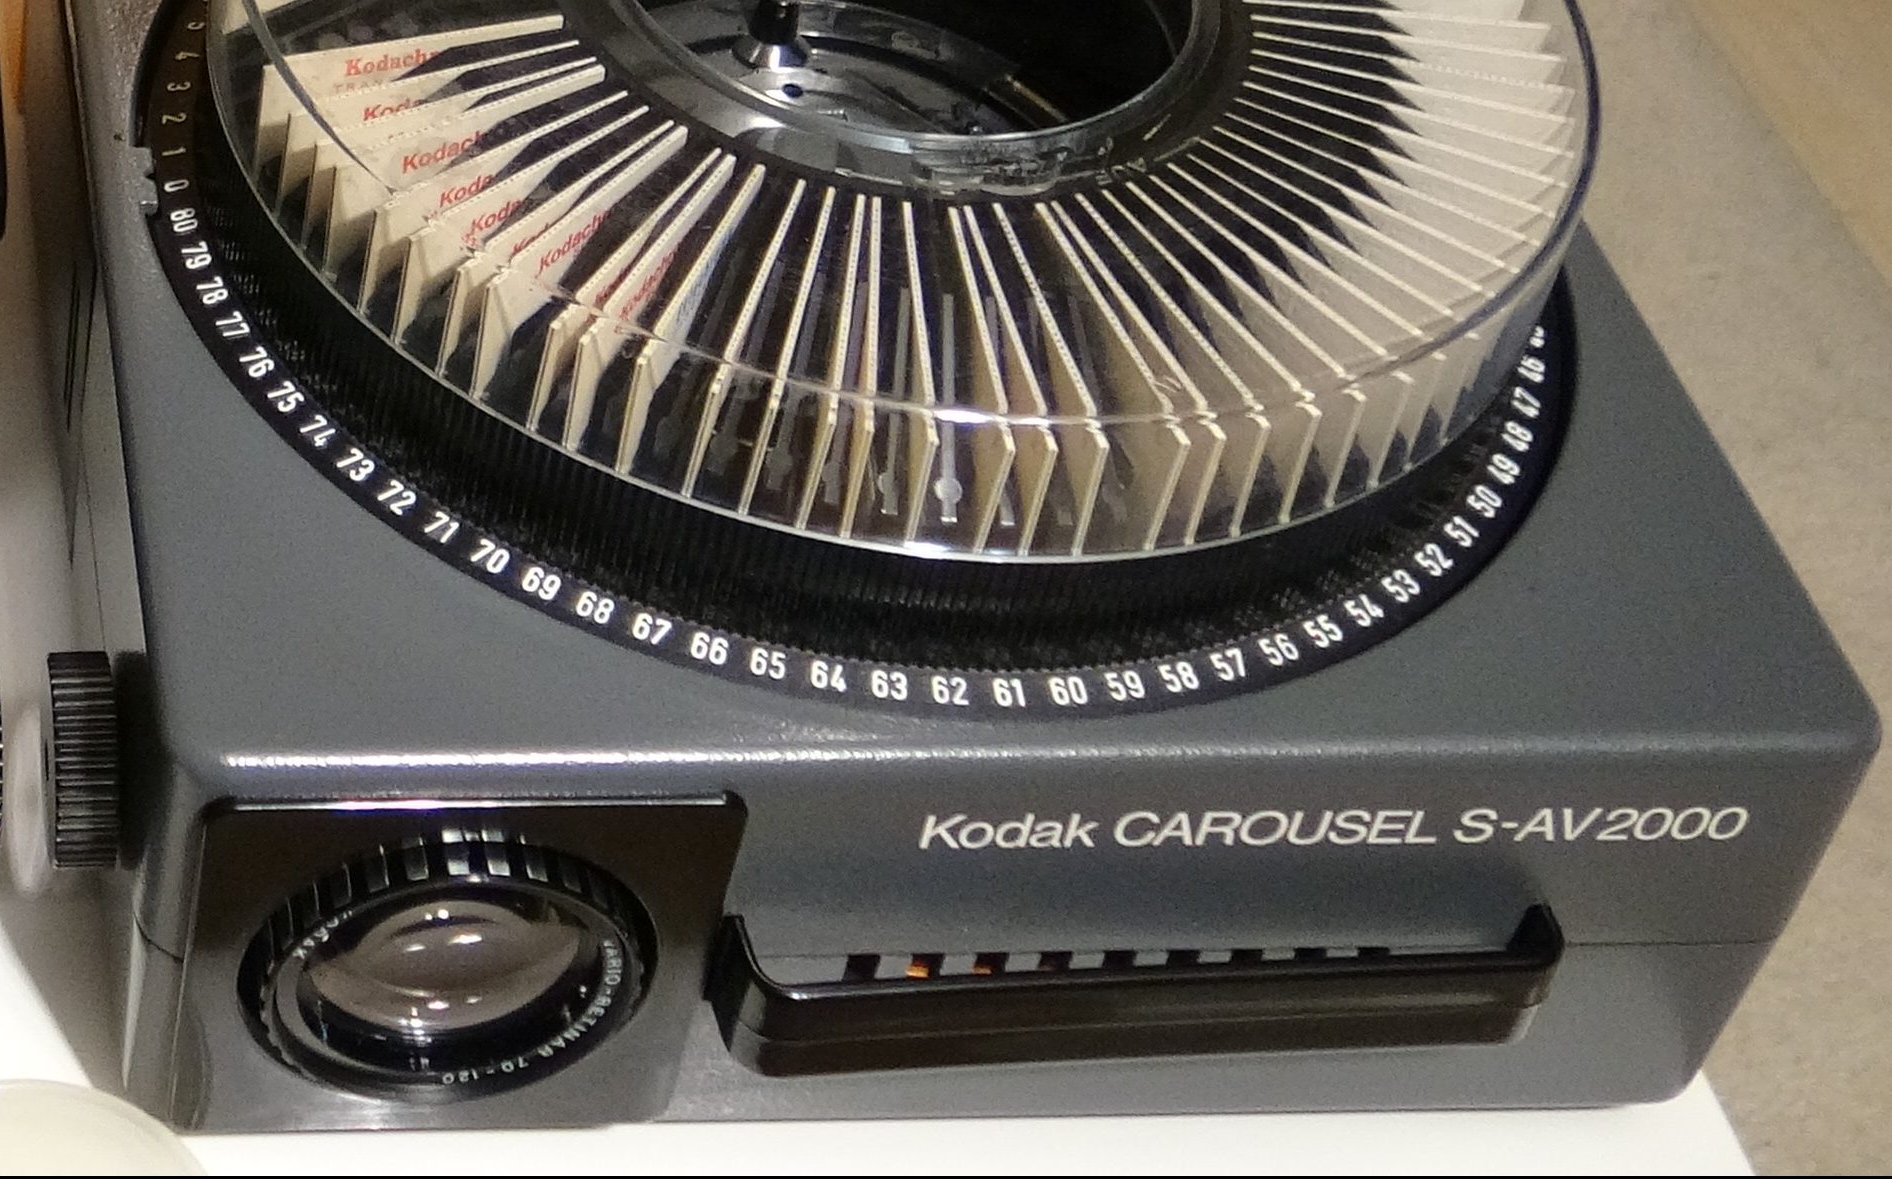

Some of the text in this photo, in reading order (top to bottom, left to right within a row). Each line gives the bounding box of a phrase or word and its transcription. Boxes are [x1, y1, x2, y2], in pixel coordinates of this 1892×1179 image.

[161, 112, 187, 125] 2
[170, 208, 198, 233] 80
[181, 241, 212, 270] 79
[196, 276, 229, 305] 78
[215, 310, 250, 337] 77
[239, 345, 275, 378] 76
[267, 380, 305, 413] 75
[1511, 386, 1541, 418] 47
[299, 414, 336, 447] 74
[1501, 421, 1533, 452] 48
[336, 447, 375, 482] 73
[1487, 453, 1520, 485] 49
[377, 479, 417, 516] 72
[1466, 484, 1502, 518] 50
[424, 510, 460, 544] 71
[1443, 516, 1479, 547] 51
[470, 538, 510, 574] 70
[1414, 543, 1453, 577] 52
[521, 566, 562, 601] 69
[1381, 569, 1420, 603] 53
[575, 590, 615, 624] 68
[1343, 594, 1384, 627] 54
[632, 612, 673, 645] 67
[1302, 614, 1343, 648] 55
[690, 631, 729, 665] 66
[749, 647, 786, 680] 65
[1209, 647, 1246, 681] 57
[1257, 633, 1299, 666] 56
[810, 660, 847, 692] 64
[871, 669, 908, 701] 63
[931, 675, 970, 706] 62
[992, 677, 1026, 707] 61
[1047, 676, 1088, 706] 60
[1104, 670, 1145, 701] 59
[1157, 661, 1200, 693] 58
[918, 812, 1100, 851] Kodak
[1113, 809, 1438, 848] CAROUSEL
